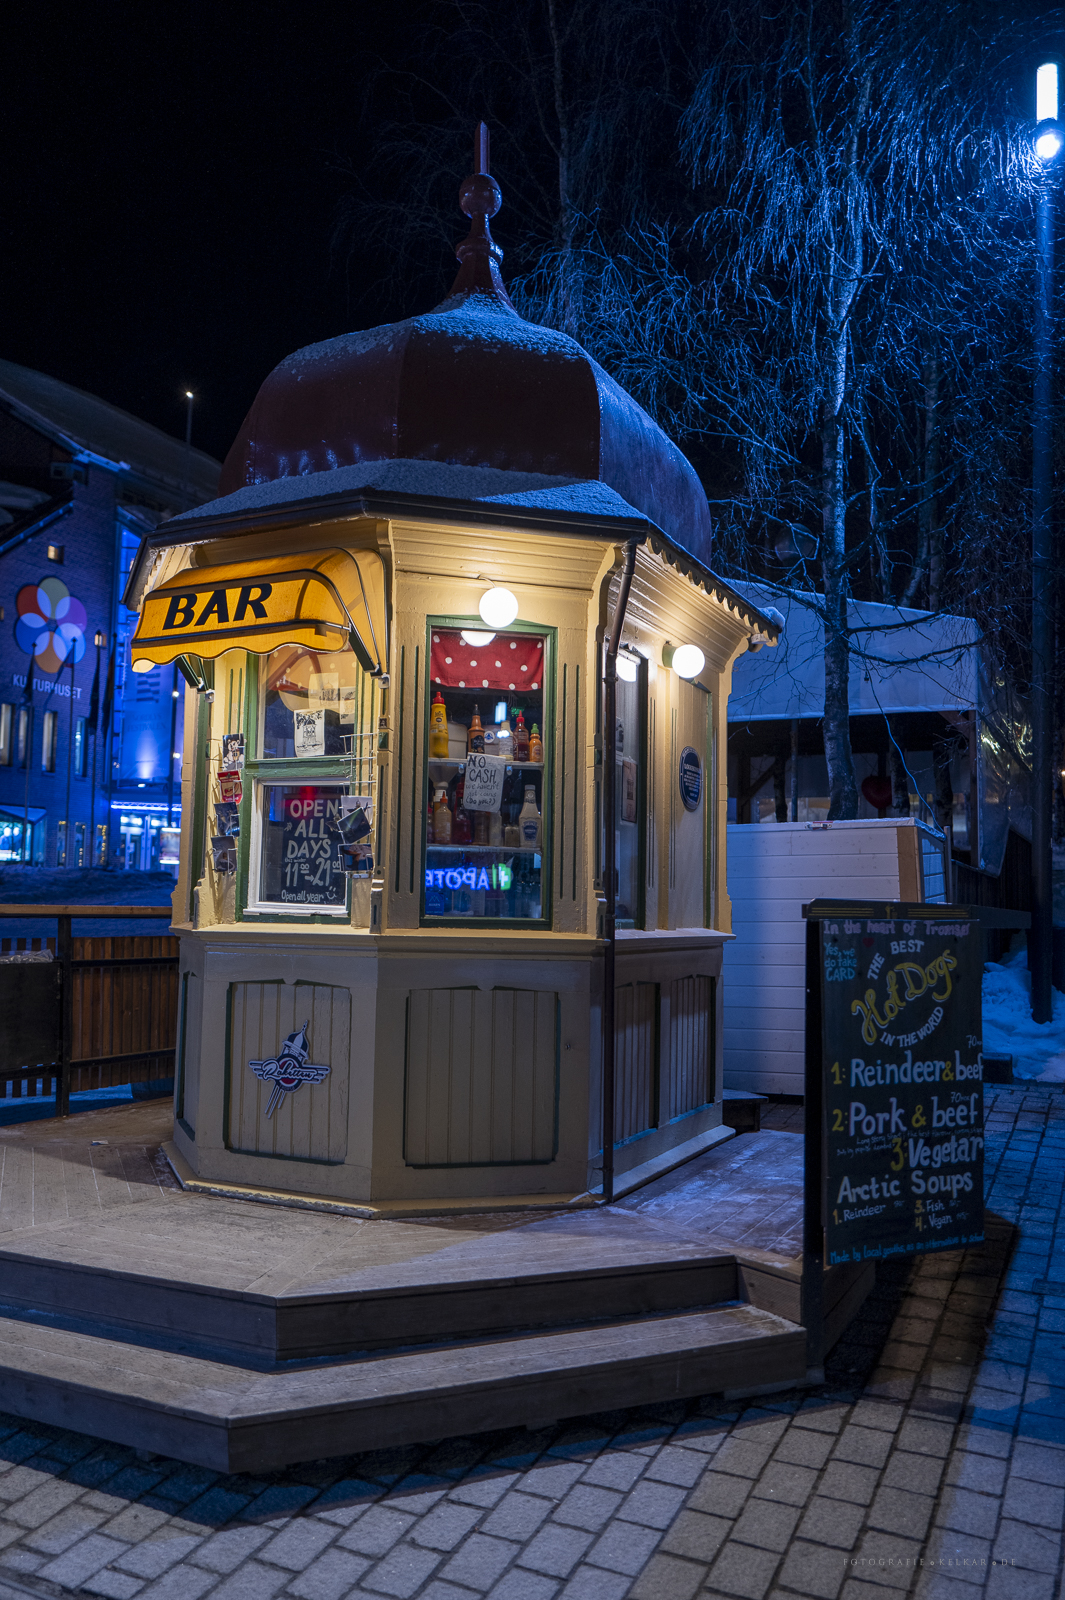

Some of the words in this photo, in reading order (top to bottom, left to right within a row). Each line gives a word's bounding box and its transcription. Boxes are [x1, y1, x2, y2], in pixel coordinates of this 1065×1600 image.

[162, 582, 272, 630] BAR
[12, 673, 83, 699] KUTURHUSET
[468, 754, 486, 768] NO
[290, 799, 339, 818] OPEN
[294, 818, 328, 838] ALL
[286, 838, 331, 858] DAYS
[281, 889, 297, 902] Open
[297, 889, 306, 901] all
[306, 892, 324, 904] year
[823, 920, 839, 934] In
[843, 919, 862, 934] the
[867, 919, 896, 934] heart
[902, 921, 917, 936] of
[823, 942, 842, 957] Yes,
[842, 948, 855, 957] we
[867, 952, 885, 980] THE
[889, 939, 925, 955] BEST
[824, 957, 836, 967] do
[837, 955, 857, 968] take
[825, 967, 856, 981] CARD
[851, 970, 907, 1046] Hot
[894, 949, 958, 1003] Dogs
[880, 1032, 896, 1047] IN
[896, 1035, 918, 1048] THE
[916, 1006, 944, 1040] WORLD
[262, 1059, 317, 1081] Raketten
[830, 1061, 846, 1085] 1:
[850, 1050, 945, 1087] Reindeer
[941, 1060, 955, 1082] &
[954, 1050, 983, 1081] beef
[832, 1108, 848, 1132] 2:
[849, 1096, 907, 1137] Pork
[911, 1104, 927, 1128] &
[930, 1092, 979, 1128] beef
[890, 1137, 908, 1171] 3:
[908, 1135, 984, 1168] Vegetar
[836, 1173, 901, 1204] Arctic
[911, 1169, 974, 1199] Soups
[832, 1208, 843, 1225] 1.
[843, 1204, 887, 1222] Reindeer
[914, 1199, 925, 1214] 3.
[926, 1199, 945, 1213] Fish
[915, 1216, 927, 1232] 4.
[928, 1213, 953, 1229] Vegan
[830, 1250, 850, 1264] Made
[852, 1247, 862, 1262] by
